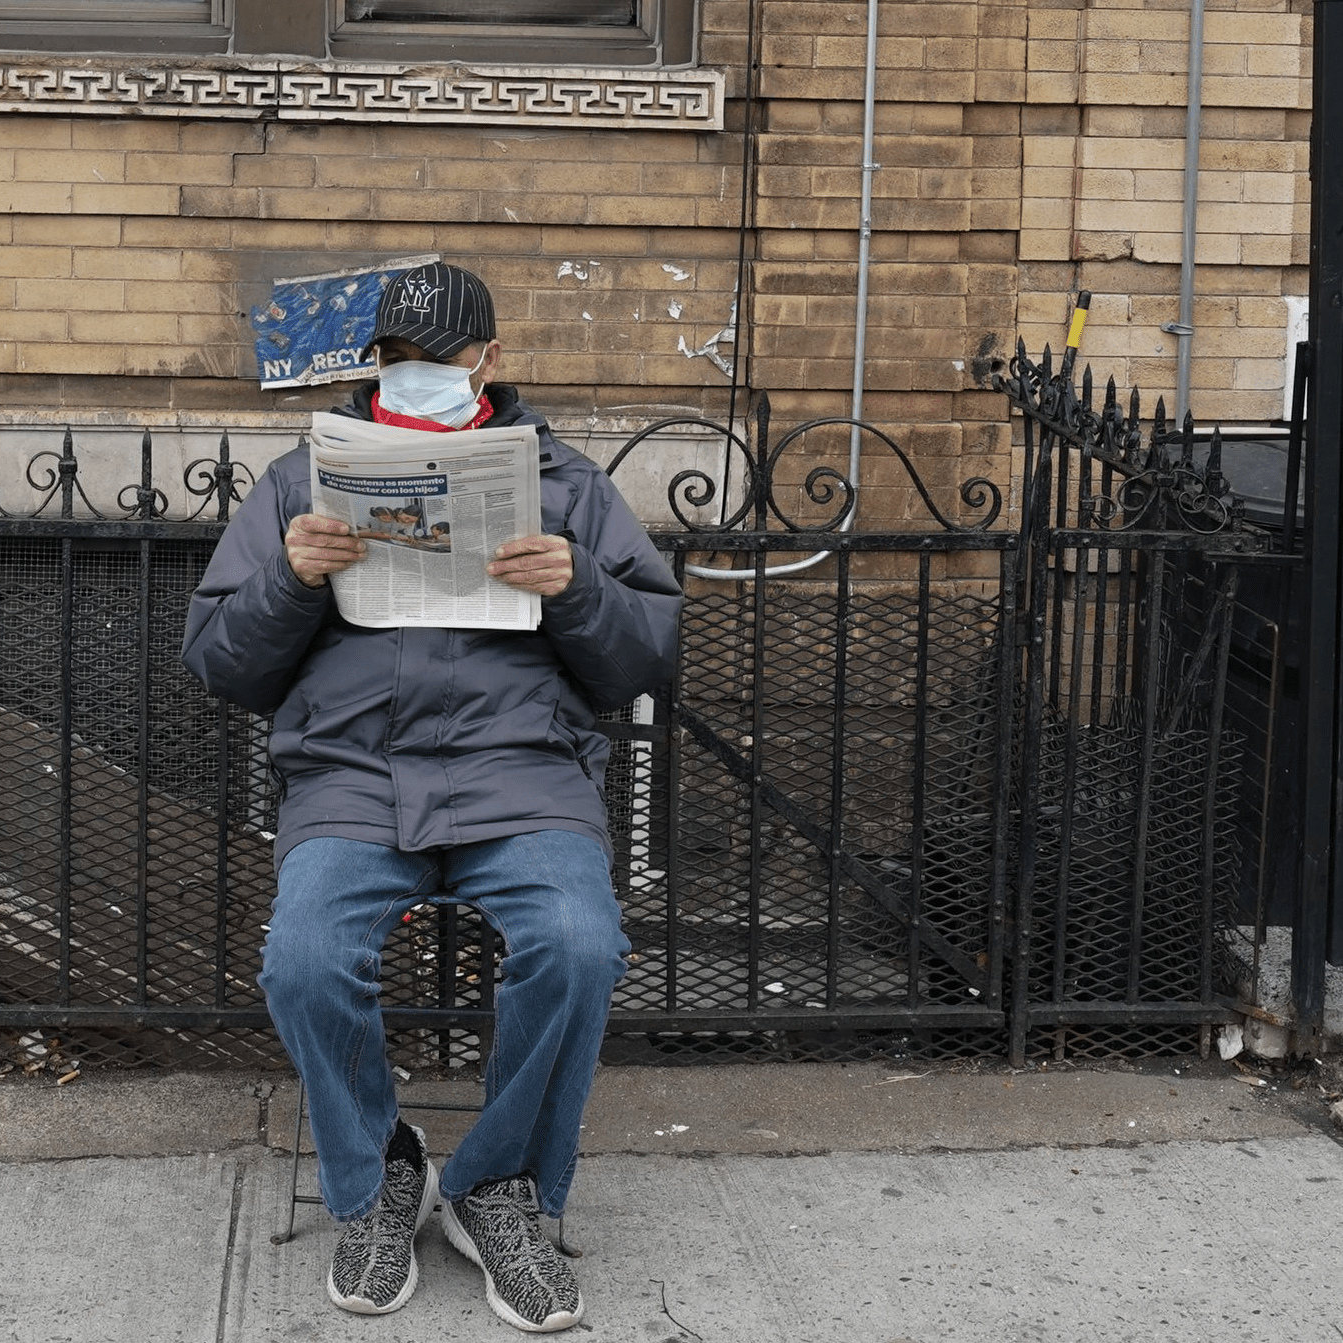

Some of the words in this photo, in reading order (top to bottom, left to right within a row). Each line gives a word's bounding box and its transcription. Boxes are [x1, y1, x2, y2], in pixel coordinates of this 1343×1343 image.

[392, 277, 445, 312] NY
[263, 358, 292, 379] NY
[326, 480, 338, 488] de
[339, 483, 380, 493] conectar
[400, 486, 415, 494] los
[415, 485, 439, 495] hijos
[331, 475, 385, 487] cuarentena
[397, 477, 445, 487] momento
